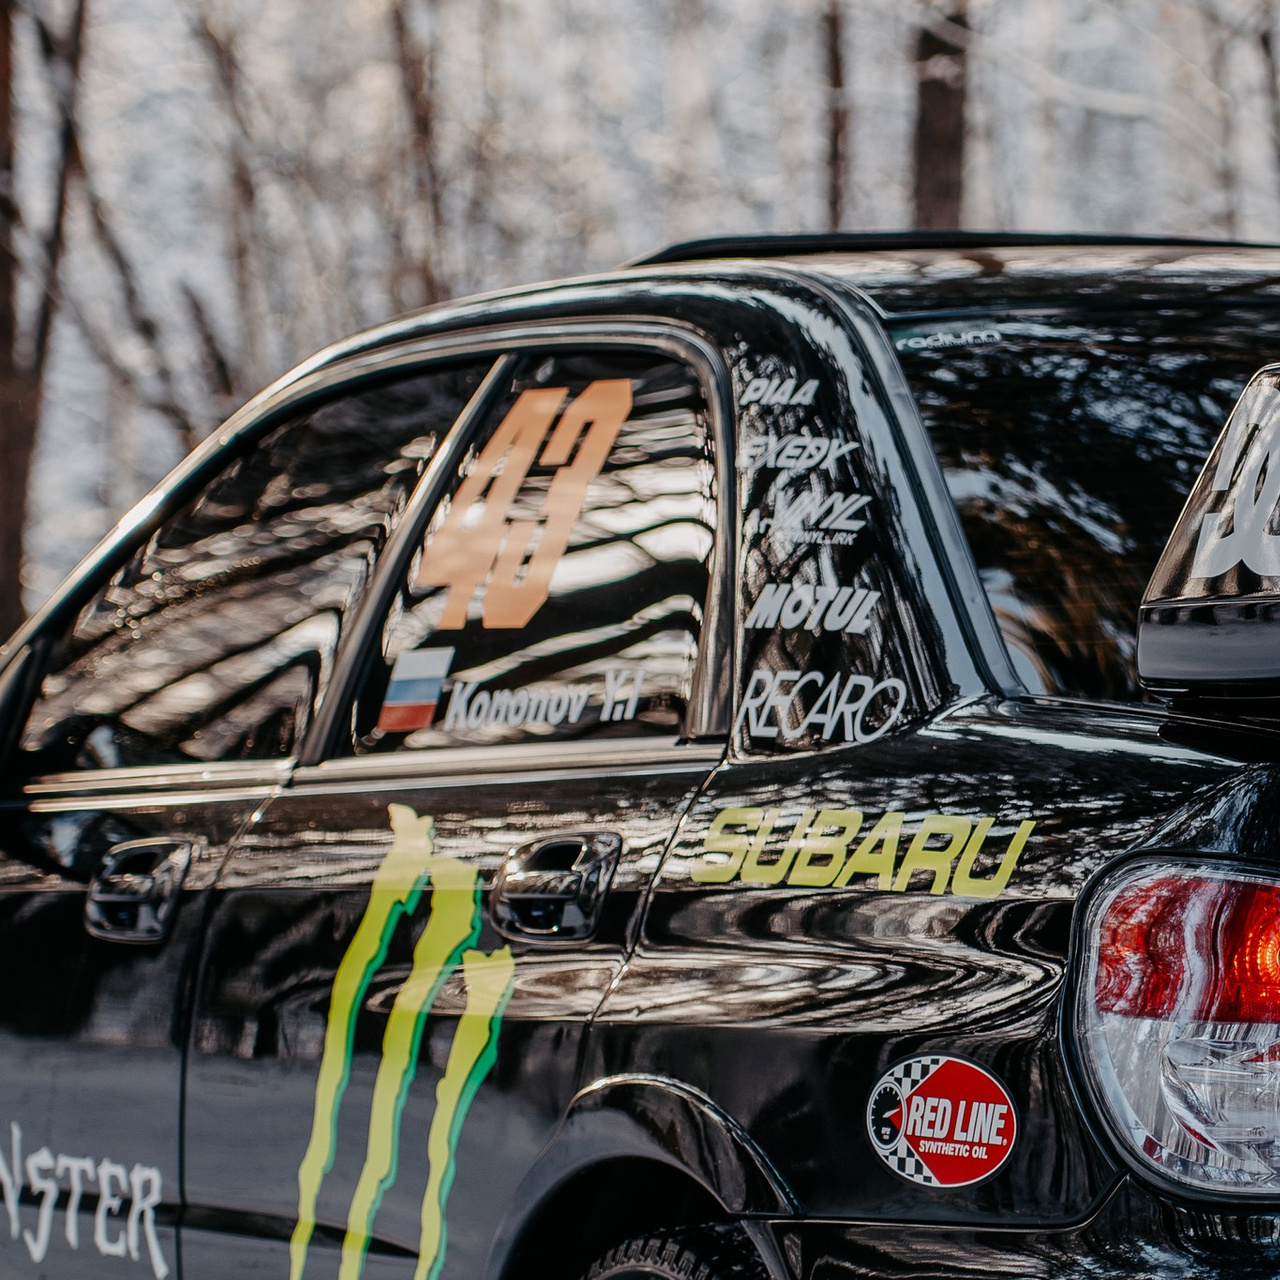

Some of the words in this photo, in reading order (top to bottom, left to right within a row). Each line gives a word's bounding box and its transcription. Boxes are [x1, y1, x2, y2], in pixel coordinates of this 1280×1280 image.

[740, 378, 820, 405] PIAA
[735, 433, 860, 470] EXEDY
[415, 378, 633, 630] 43
[745, 584, 882, 635] MOTUL
[444, 681, 591, 731] Kononov
[740, 670, 908, 744] RECARO
[690, 807, 1037, 897] SUBARU
[906, 1095, 953, 1139] RED
[918, 1140, 970, 1157] SYNTHETIC
[971, 1145, 988, 1159] OIL
